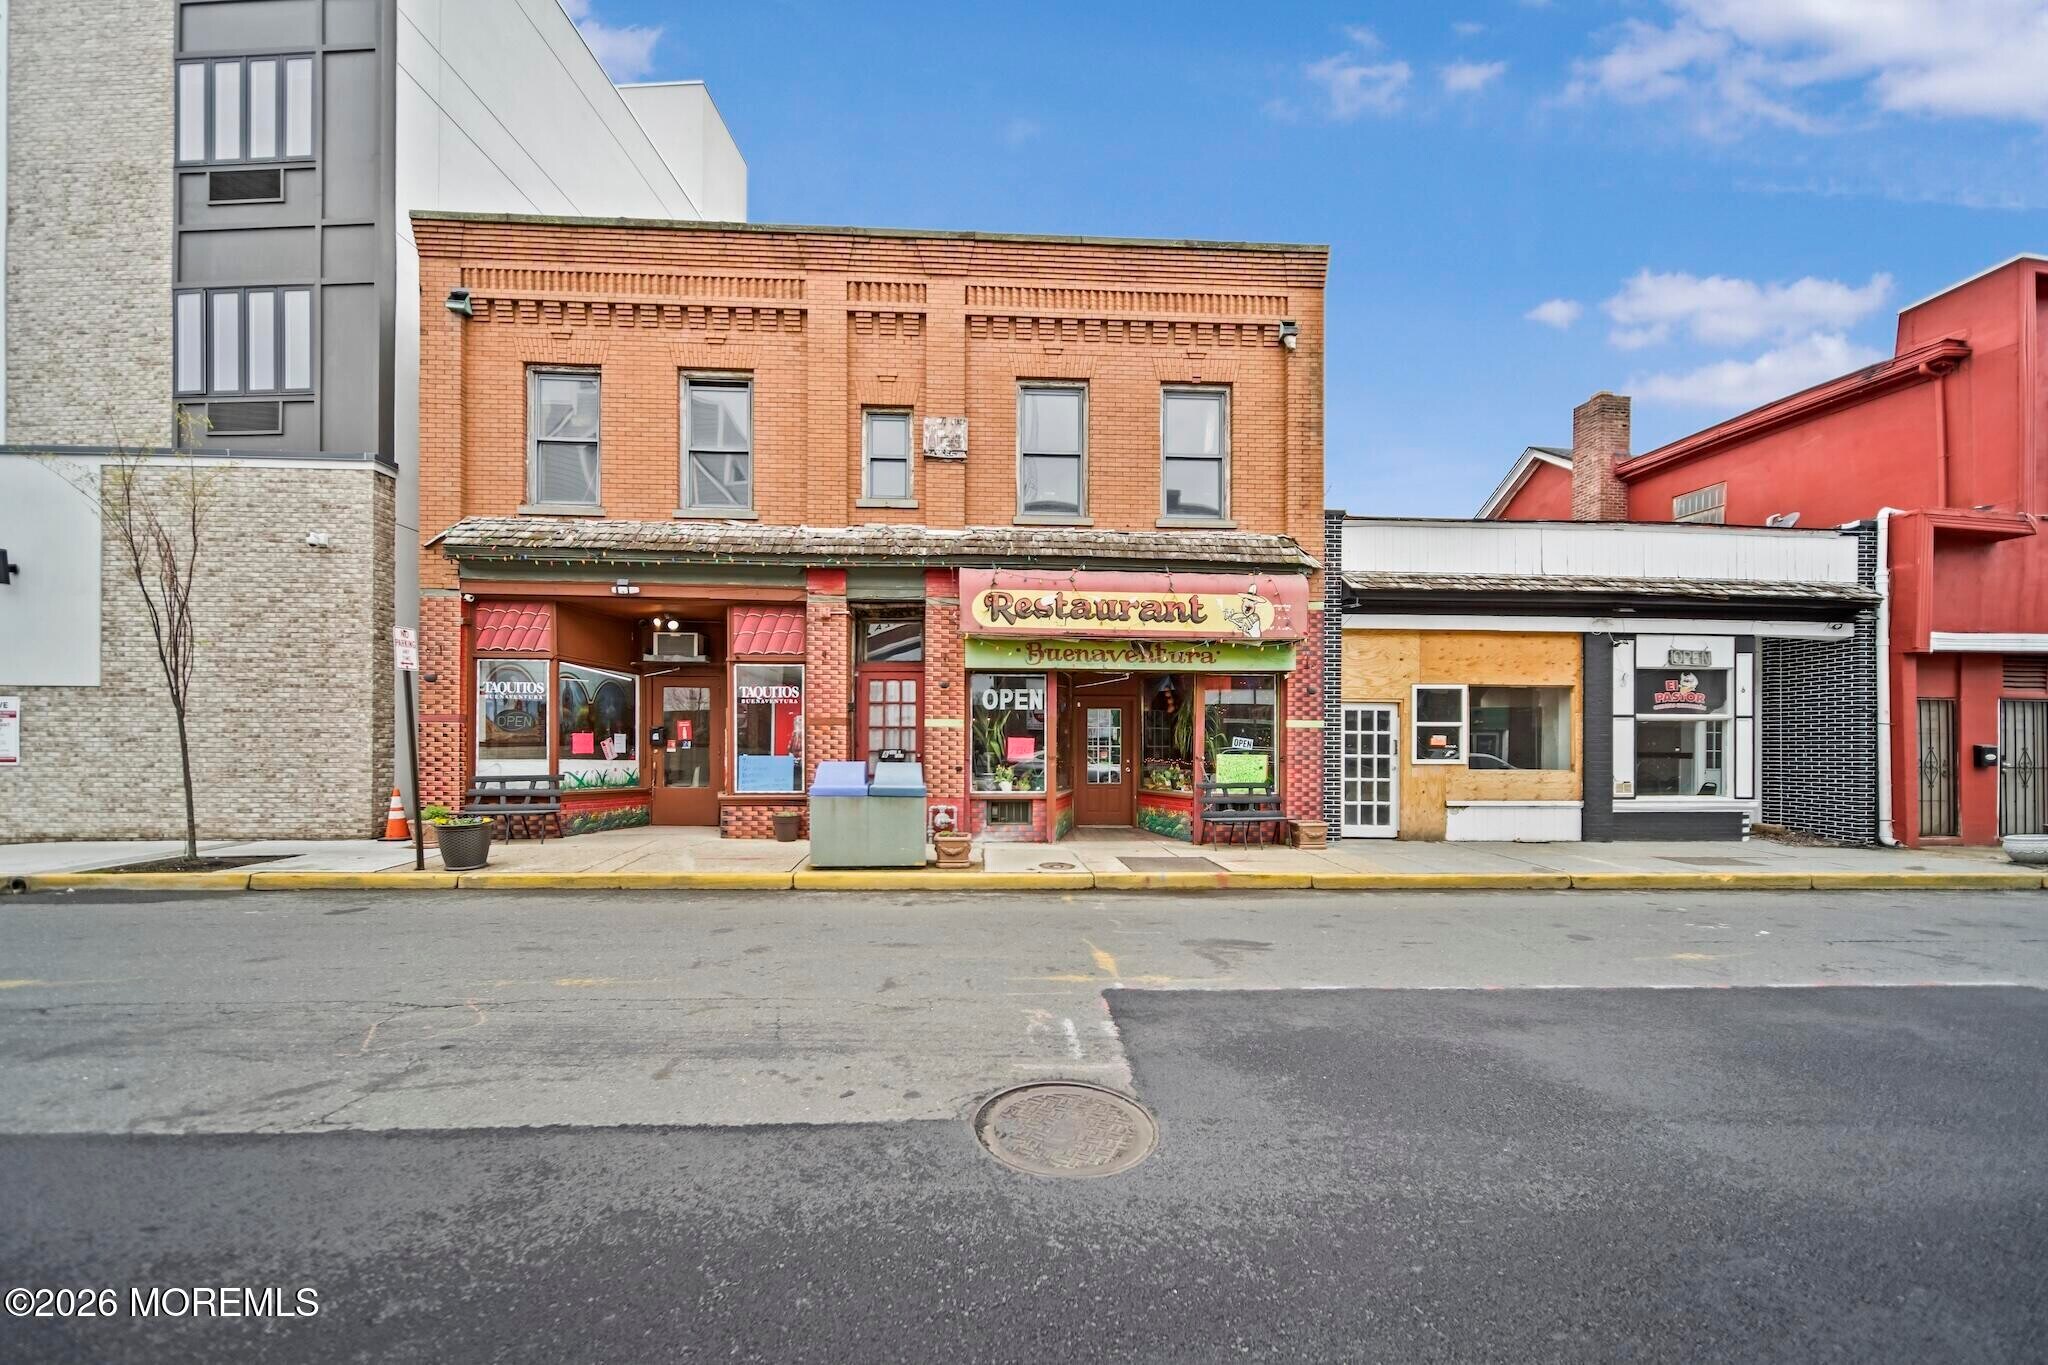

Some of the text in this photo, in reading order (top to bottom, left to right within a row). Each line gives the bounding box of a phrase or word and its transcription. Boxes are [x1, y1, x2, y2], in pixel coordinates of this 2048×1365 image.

[984, 590, 1208, 625] Restaurant
[1671, 651, 1711, 665] OPEN
[483, 681, 545, 695] TAQUITOS
[739, 686, 800, 699] TAQUITOS
[982, 688, 1044, 710] OPEN
[1654, 691, 1706, 703] PASTOR
[497, 715, 533, 728] OPEN
[1233, 738, 1252, 748] OPEN
